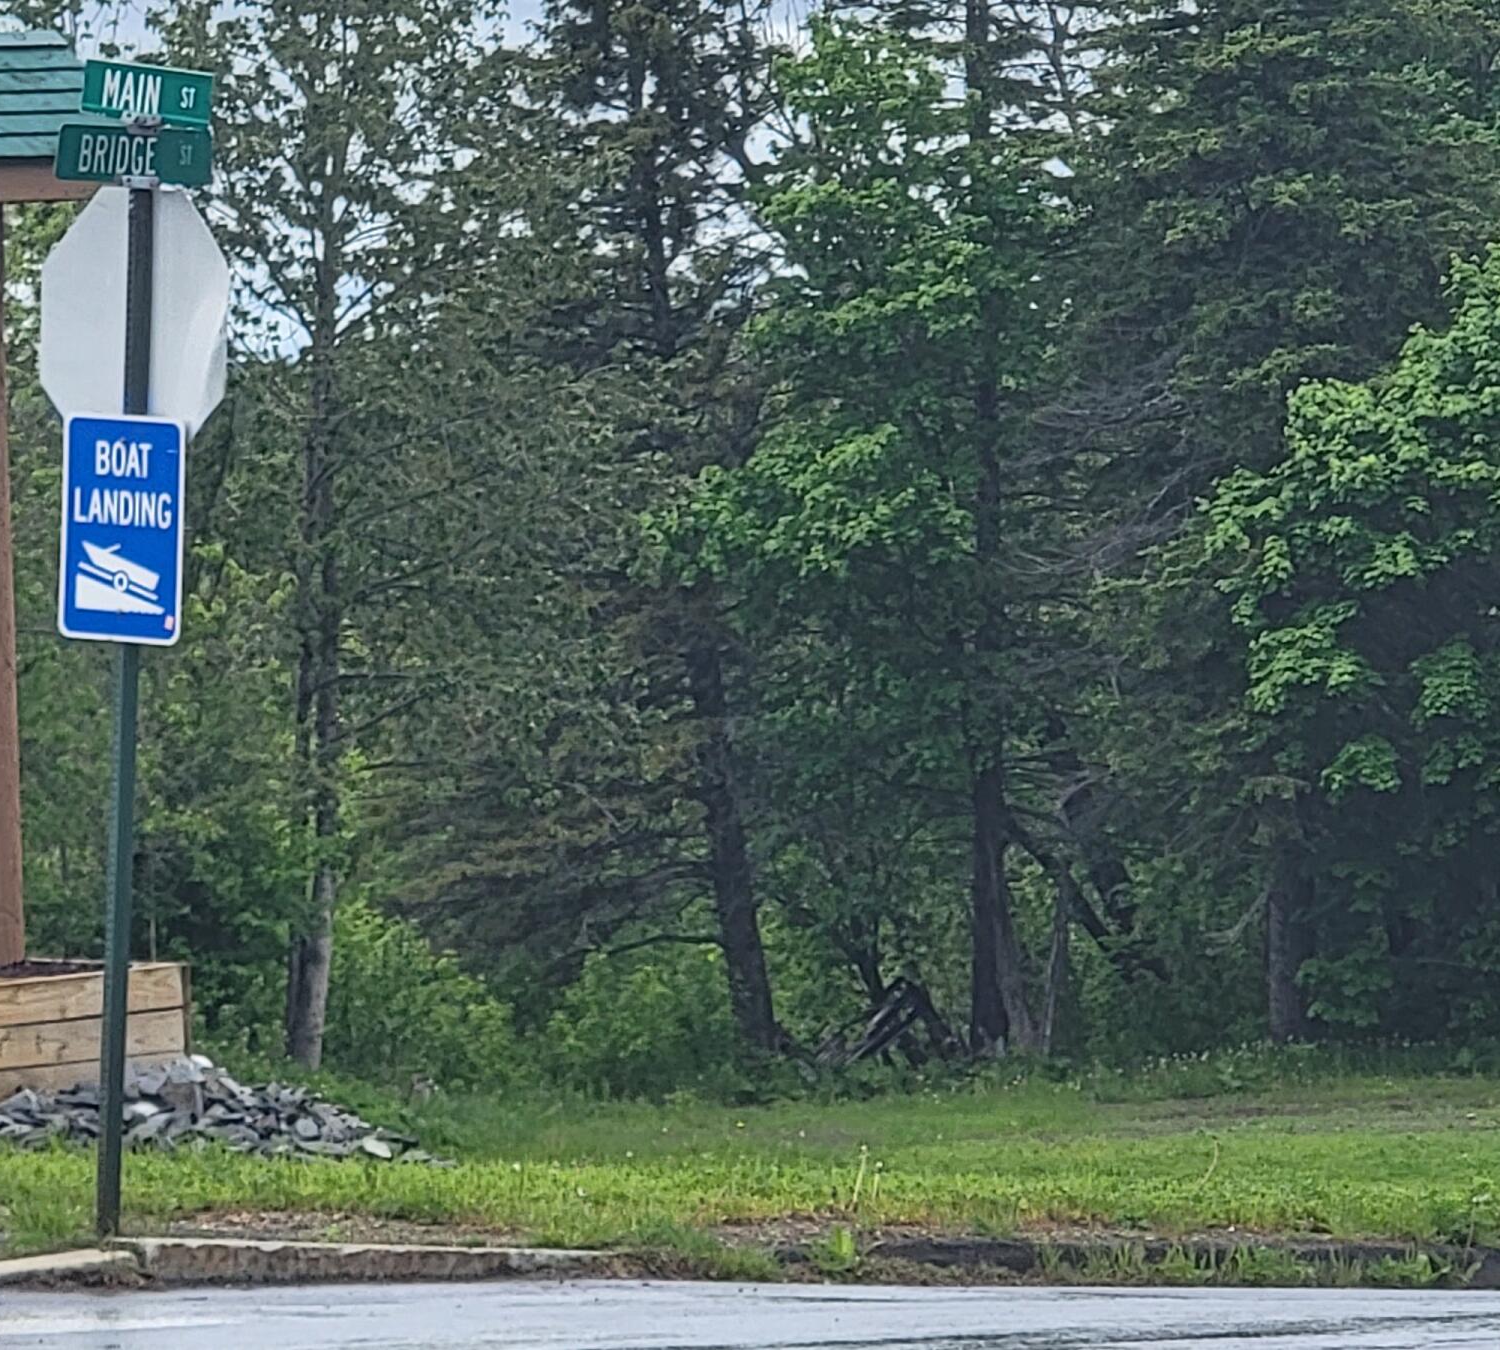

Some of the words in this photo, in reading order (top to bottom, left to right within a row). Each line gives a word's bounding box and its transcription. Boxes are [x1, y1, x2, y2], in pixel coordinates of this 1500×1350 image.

[101, 68, 162, 115] MAIN
[180, 87, 196, 108] ST
[77, 133, 159, 175] BRIDGE
[180, 145, 192, 165] ST
[94, 439, 153, 479] BOAT
[73, 486, 172, 530] LANDING
